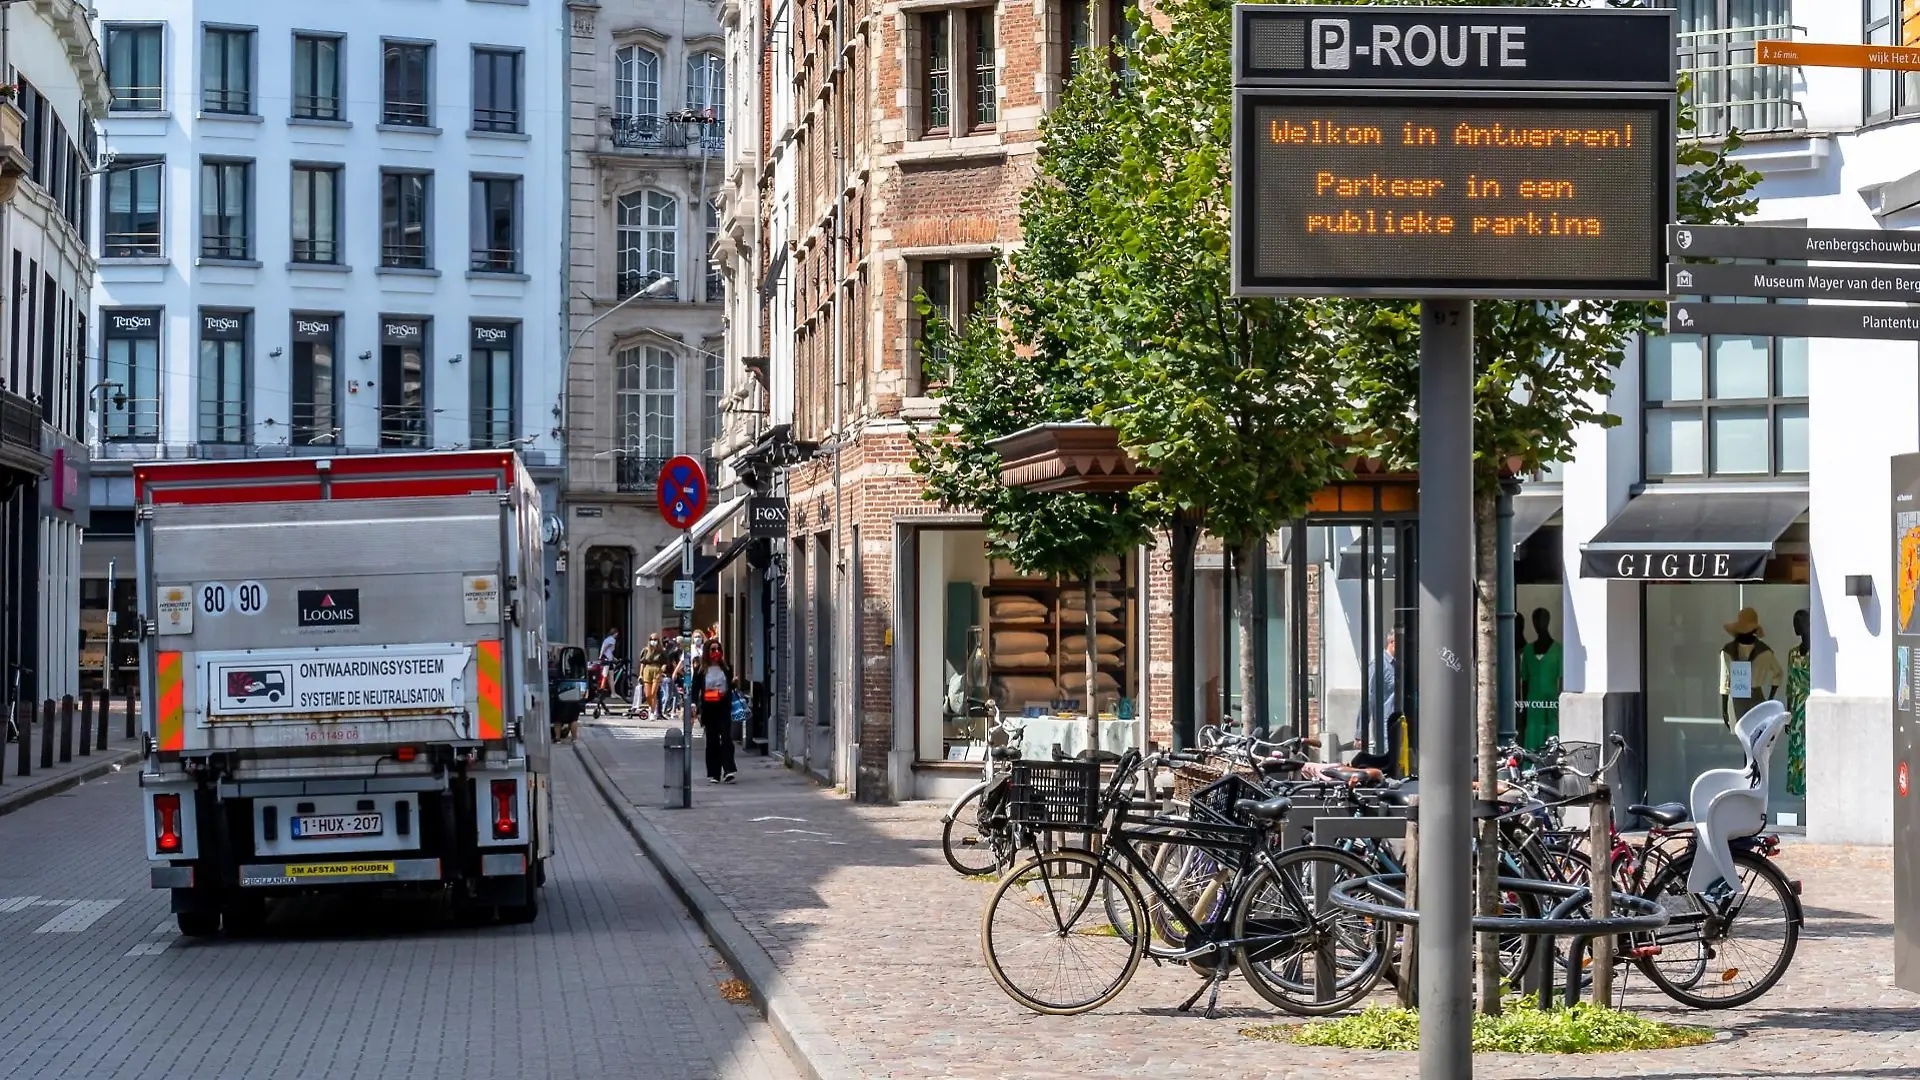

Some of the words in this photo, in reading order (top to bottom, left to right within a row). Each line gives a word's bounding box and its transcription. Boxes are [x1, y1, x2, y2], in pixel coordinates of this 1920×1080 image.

[1312, 19, 1527, 69] P-ROUTE
[1868, 52, 1889, 65] wijk
[1891, 52, 1908, 64] Het
[1270, 120, 1382, 145] Welkom
[1403, 122, 1437, 145] in
[1455, 122, 1633, 148] Antwerpen!
[1316, 171, 1445, 198] Parkeer
[1468, 174, 1501, 198] in
[1519, 179, 1574, 198] een
[1307, 209, 1455, 234] publieke
[1472, 212, 1601, 236] parking
[1753, 274, 1805, 289] Museum
[1808, 275, 1844, 291] Mayer
[1847, 279, 1868, 290] van
[1871, 277, 1892, 290] den
[1895, 277, 1920, 293] Berg
[113, 316, 151, 328] TenSen
[204, 317, 239, 329] TenSen
[1434, 310, 1460, 326] 97
[1862, 315, 1920, 329] Plantentu
[296, 320, 329, 333] TenSen
[385, 324, 418, 336] TenSen
[474, 327, 507, 339] TenSen
[755, 507, 786, 520] FOX
[1617, 553, 1730, 577] GIGUE
[204, 586, 225, 613] 80
[239, 584, 261, 612] 90
[303, 608, 354, 621] LOOMIS
[299, 659, 444, 678] ONTWAARDINGSYSTEEM
[300, 690, 345, 707] SYSTEME
[347, 690, 361, 706] DE
[363, 688, 445, 706] NEUTRALISATION
[291, 867, 305, 875] 5M
[307, 865, 348, 874] AFSTAND
[350, 864, 389, 873] HOUDEN
